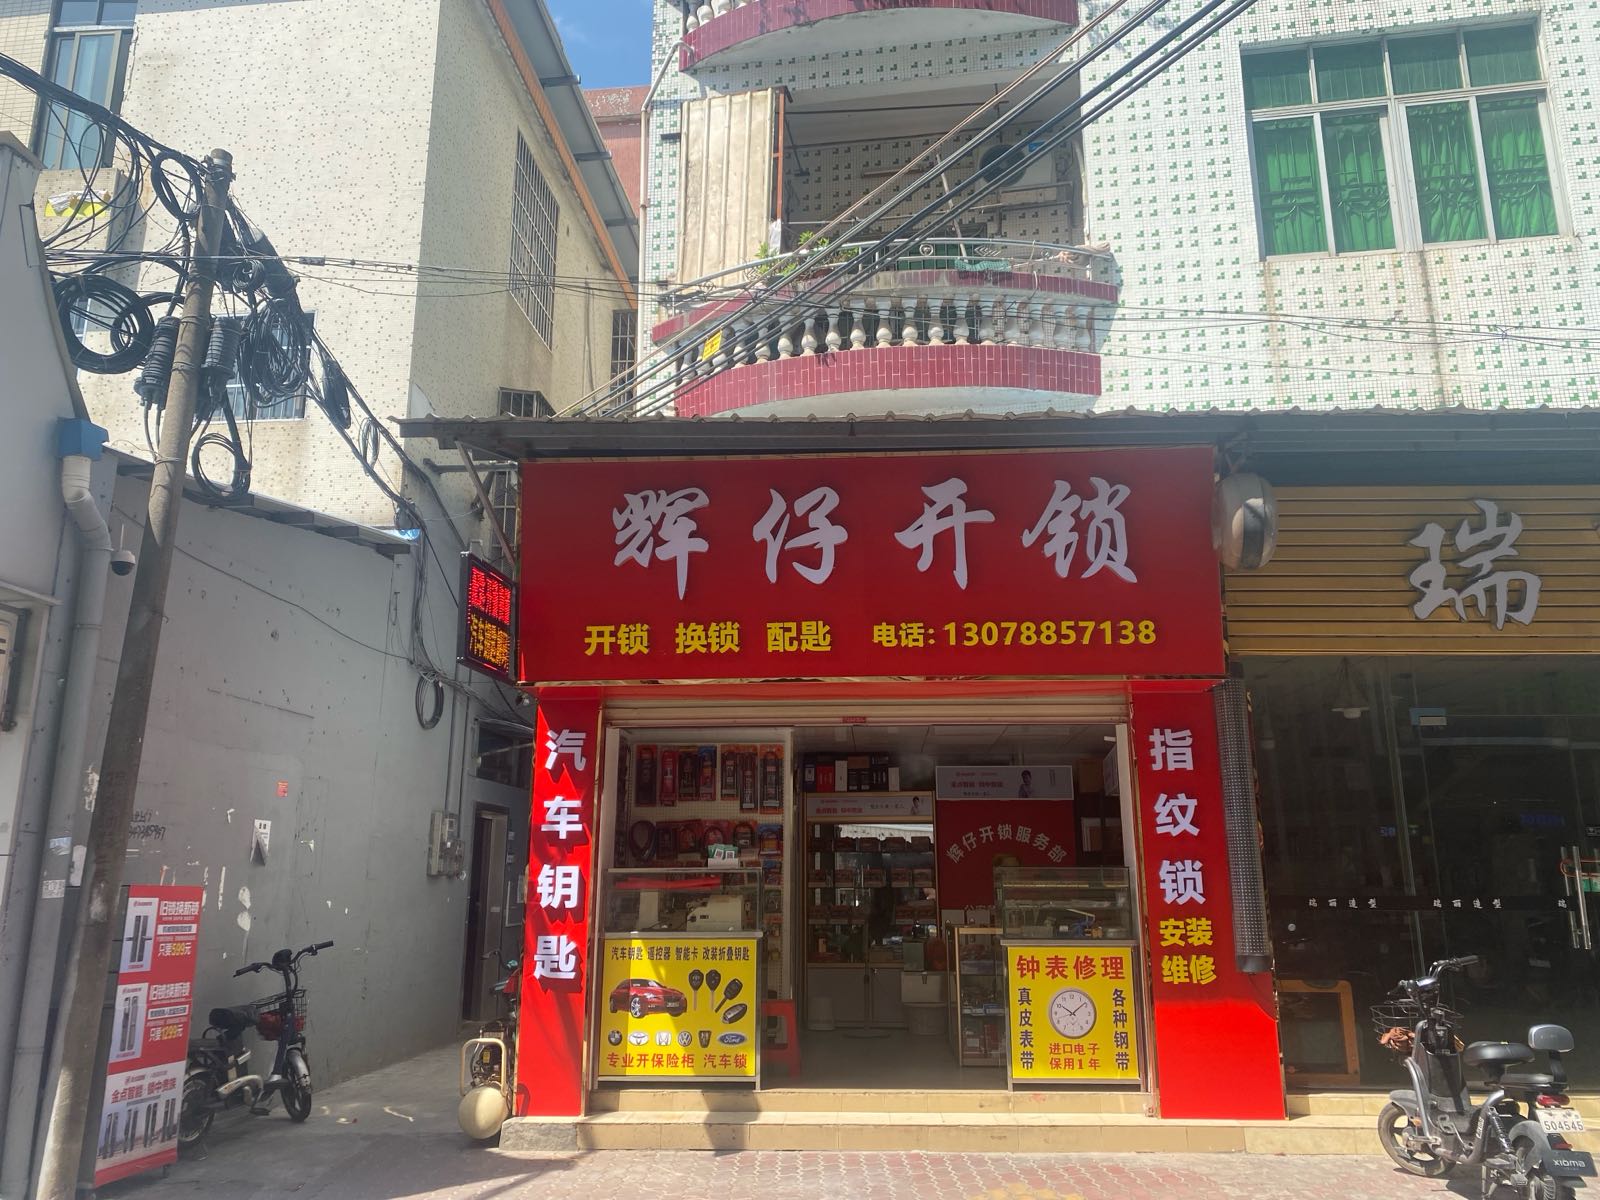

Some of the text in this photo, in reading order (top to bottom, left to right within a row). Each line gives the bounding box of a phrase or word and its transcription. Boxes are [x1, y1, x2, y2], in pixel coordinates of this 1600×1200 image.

[612, 477, 1138, 600] 辉仔开锁
[1409, 499, 1542, 630] 瑞
[584, 623, 649, 655] 开锁
[675, 621, 740, 654] 换锁
[766, 621, 832, 652] 配匙
[1149, 728, 1207, 905] 指纹锁
[533, 729, 587, 980] 汽车钥匙
[946, 823, 1068, 864] 辉仔开锁服务部
[1160, 917, 1213, 947] 安装
[611, 946, 750, 961] 汽车钥匙 遥控器 智能卡 改装折叠钥匙
[1016, 955, 1126, 980] 钟表修理
[1161, 955, 1217, 985] 维修
[1018, 987, 1034, 1070] 真皮表带
[1112, 988, 1130, 1071] 各种钢带
[607, 1052, 748, 1069] 专业开保险柜 汽车锁
[1049, 1043, 1100, 1055] 进口电子
[1049, 1057, 1101, 1070] 保用1年
[1543, 1120, 1584, 1131] 504545
